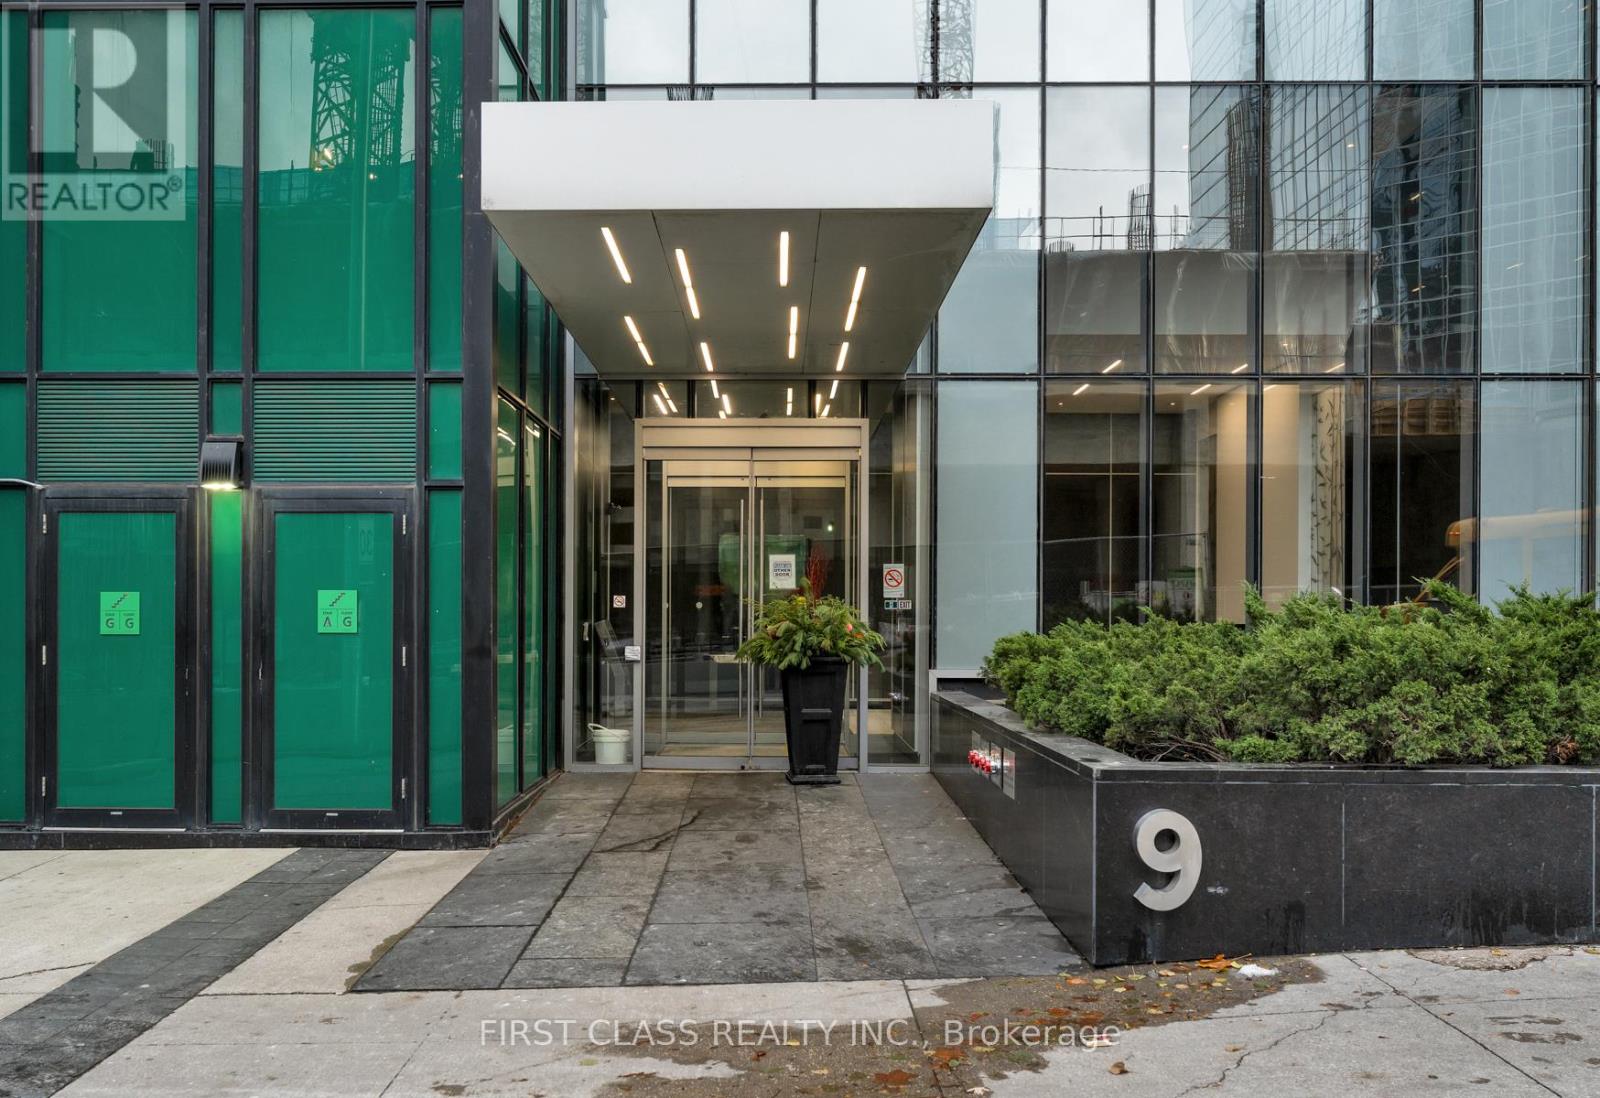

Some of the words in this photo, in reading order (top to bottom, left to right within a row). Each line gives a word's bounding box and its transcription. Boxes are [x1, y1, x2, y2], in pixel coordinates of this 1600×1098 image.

[900, 601, 911, 609] EXIT
[105, 617, 115, 629] G
[125, 617, 134, 629] G
[323, 616, 332, 627] A
[343, 616, 352, 627] G
[1133, 808, 1202, 911] 9
